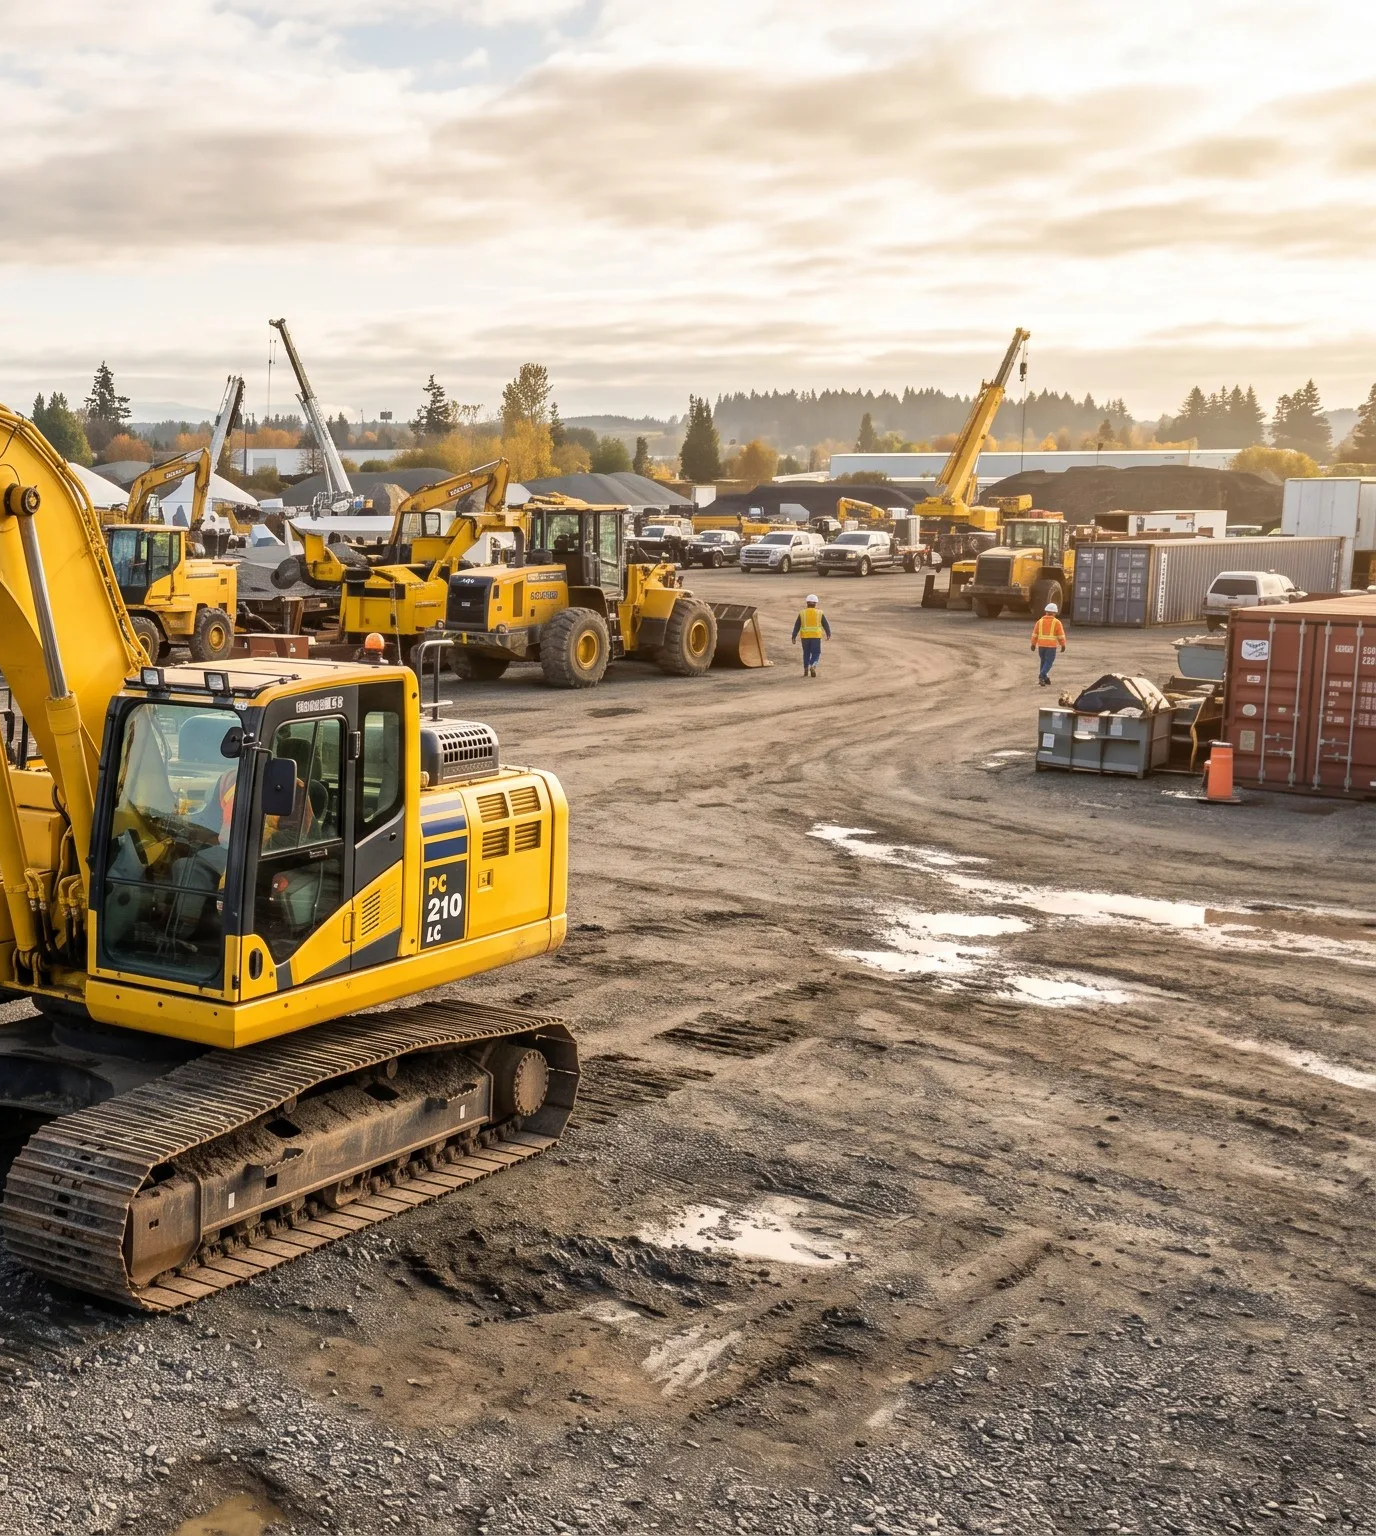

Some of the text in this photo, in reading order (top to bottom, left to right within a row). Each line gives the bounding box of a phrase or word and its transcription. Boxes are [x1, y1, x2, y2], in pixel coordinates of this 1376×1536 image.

[428, 874, 447, 895] PC
[427, 893, 462, 922] 210
[426, 924, 441, 943] LC
